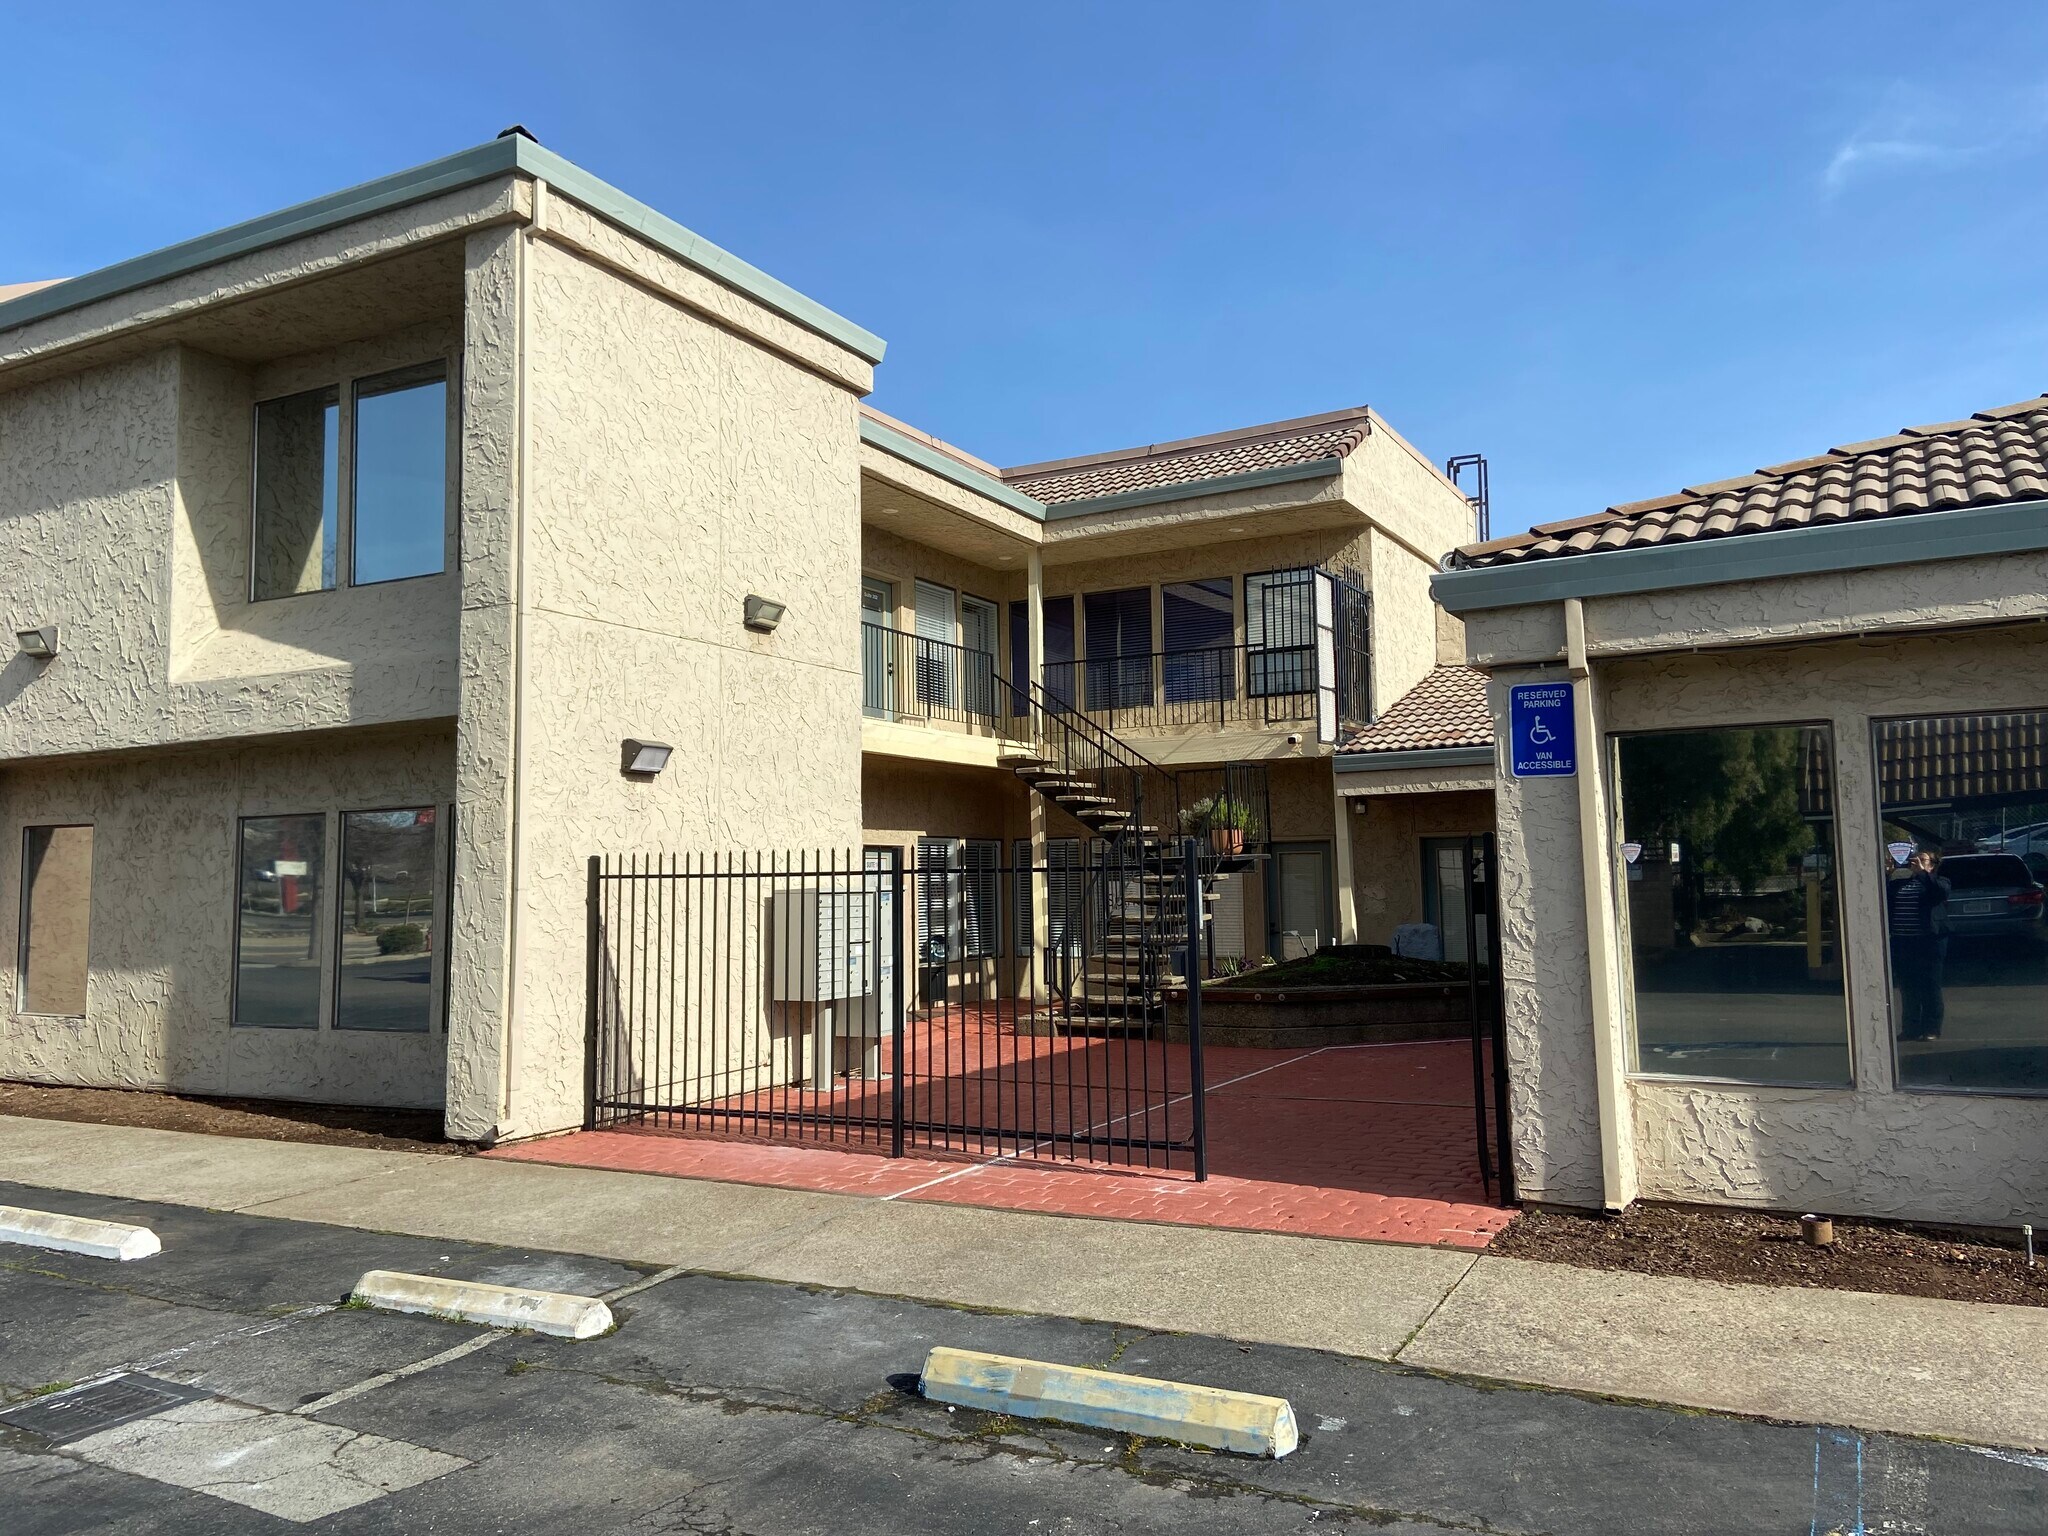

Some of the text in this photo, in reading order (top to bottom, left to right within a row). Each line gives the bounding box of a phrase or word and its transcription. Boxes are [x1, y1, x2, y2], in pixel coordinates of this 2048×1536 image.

[1518, 690, 1567, 700] RESERVED
[1524, 699, 1561, 708] PARKING
[1535, 752, 1553, 760] VAN
[1517, 760, 1572, 770] ACCESSIBLE
